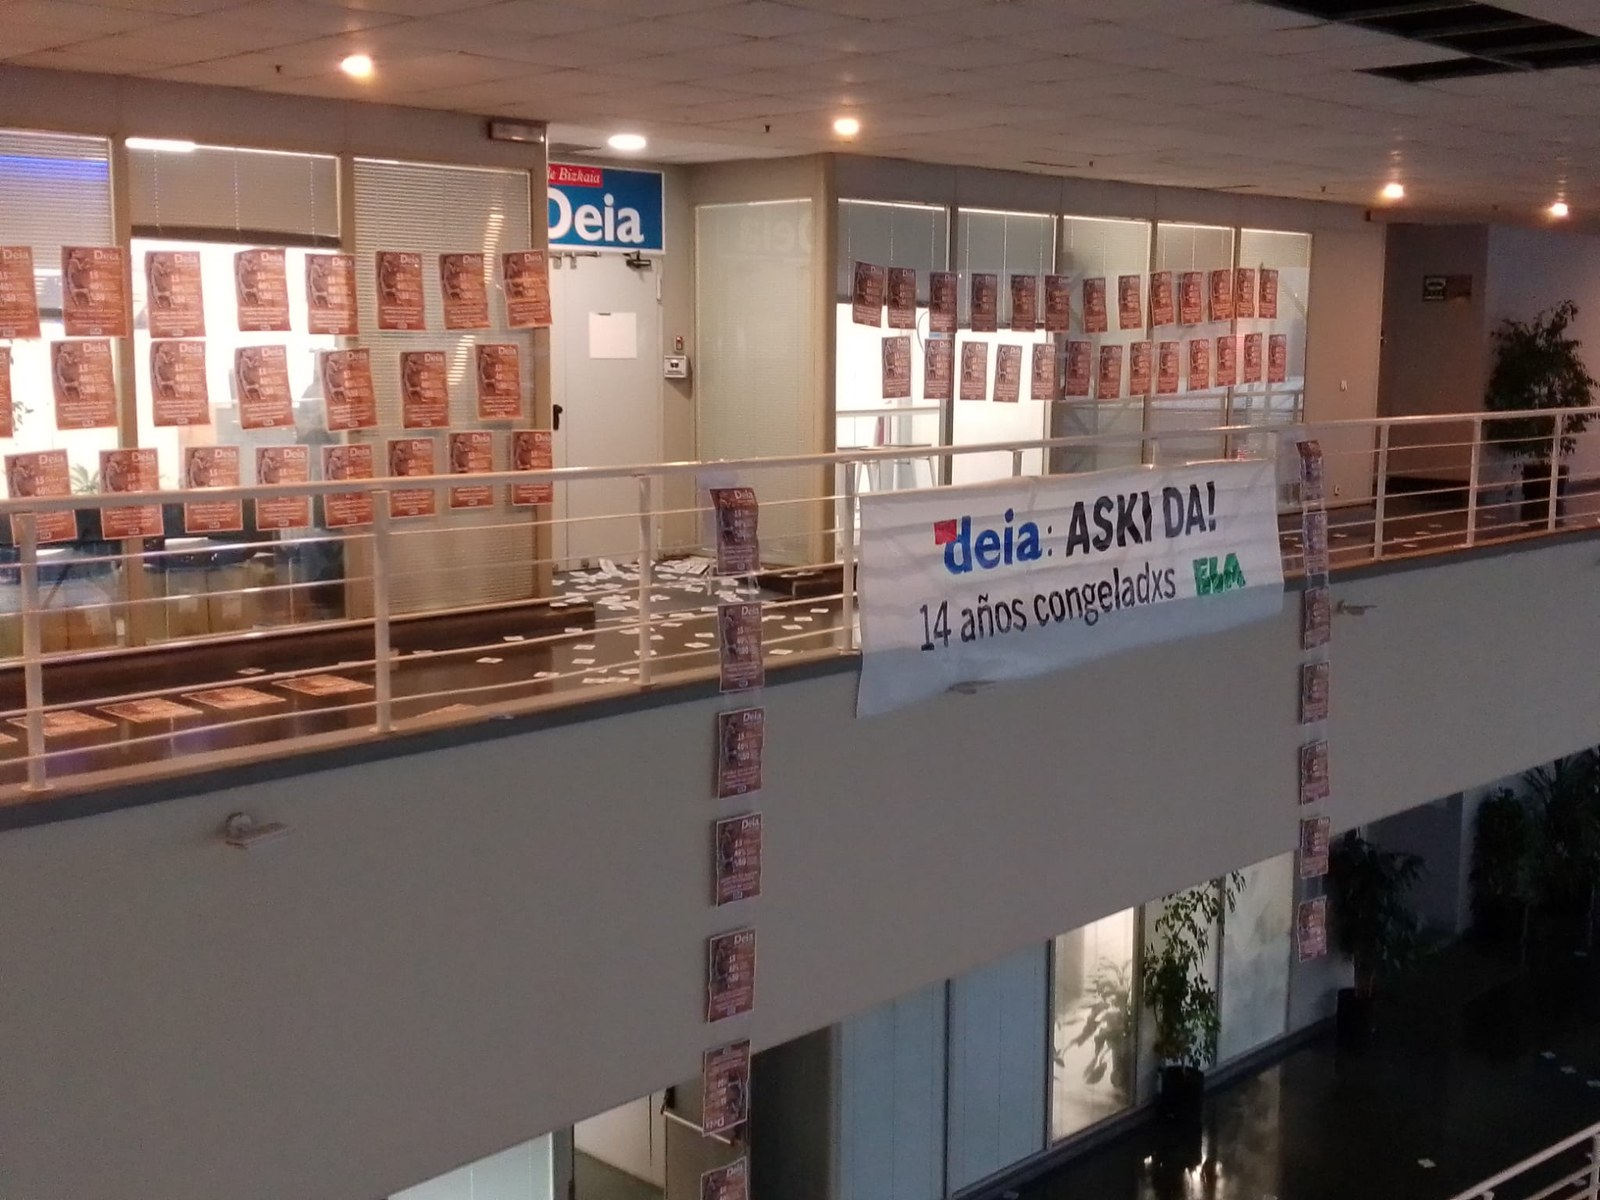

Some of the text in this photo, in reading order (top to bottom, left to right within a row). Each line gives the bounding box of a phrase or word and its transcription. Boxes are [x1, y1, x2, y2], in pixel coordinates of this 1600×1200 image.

[559, 166, 600, 184] Bizkaia
[547, 187, 645, 244] Deia
[1065, 491, 1153, 558] ASKI
[1162, 481, 1216, 538] DA!
[1192, 552, 1247, 597] ELA
[919, 561, 1177, 651] 14 años congeladxs
